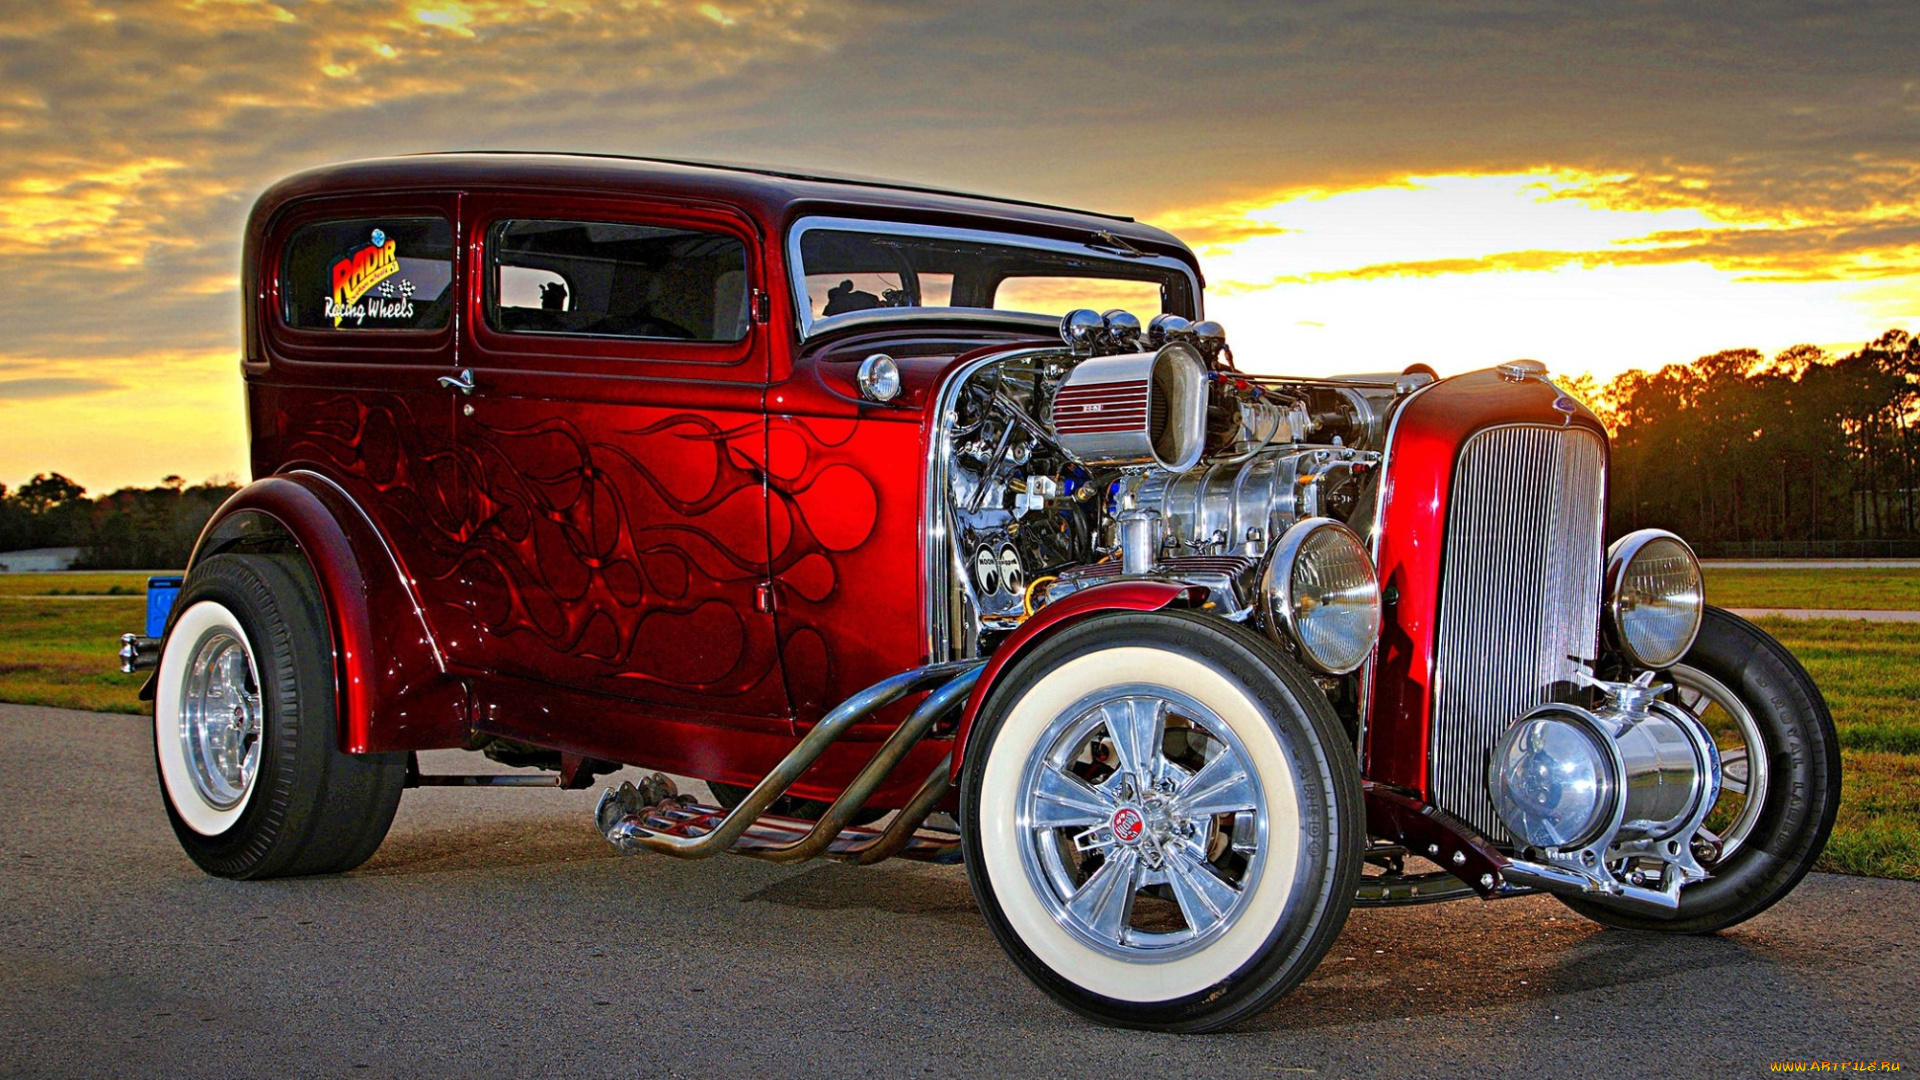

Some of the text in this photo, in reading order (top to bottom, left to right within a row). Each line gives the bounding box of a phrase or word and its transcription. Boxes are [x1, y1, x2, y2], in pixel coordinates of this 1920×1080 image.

[324, 296, 414, 325] Racing Wheels
[332, 239, 397, 328] RADIR
